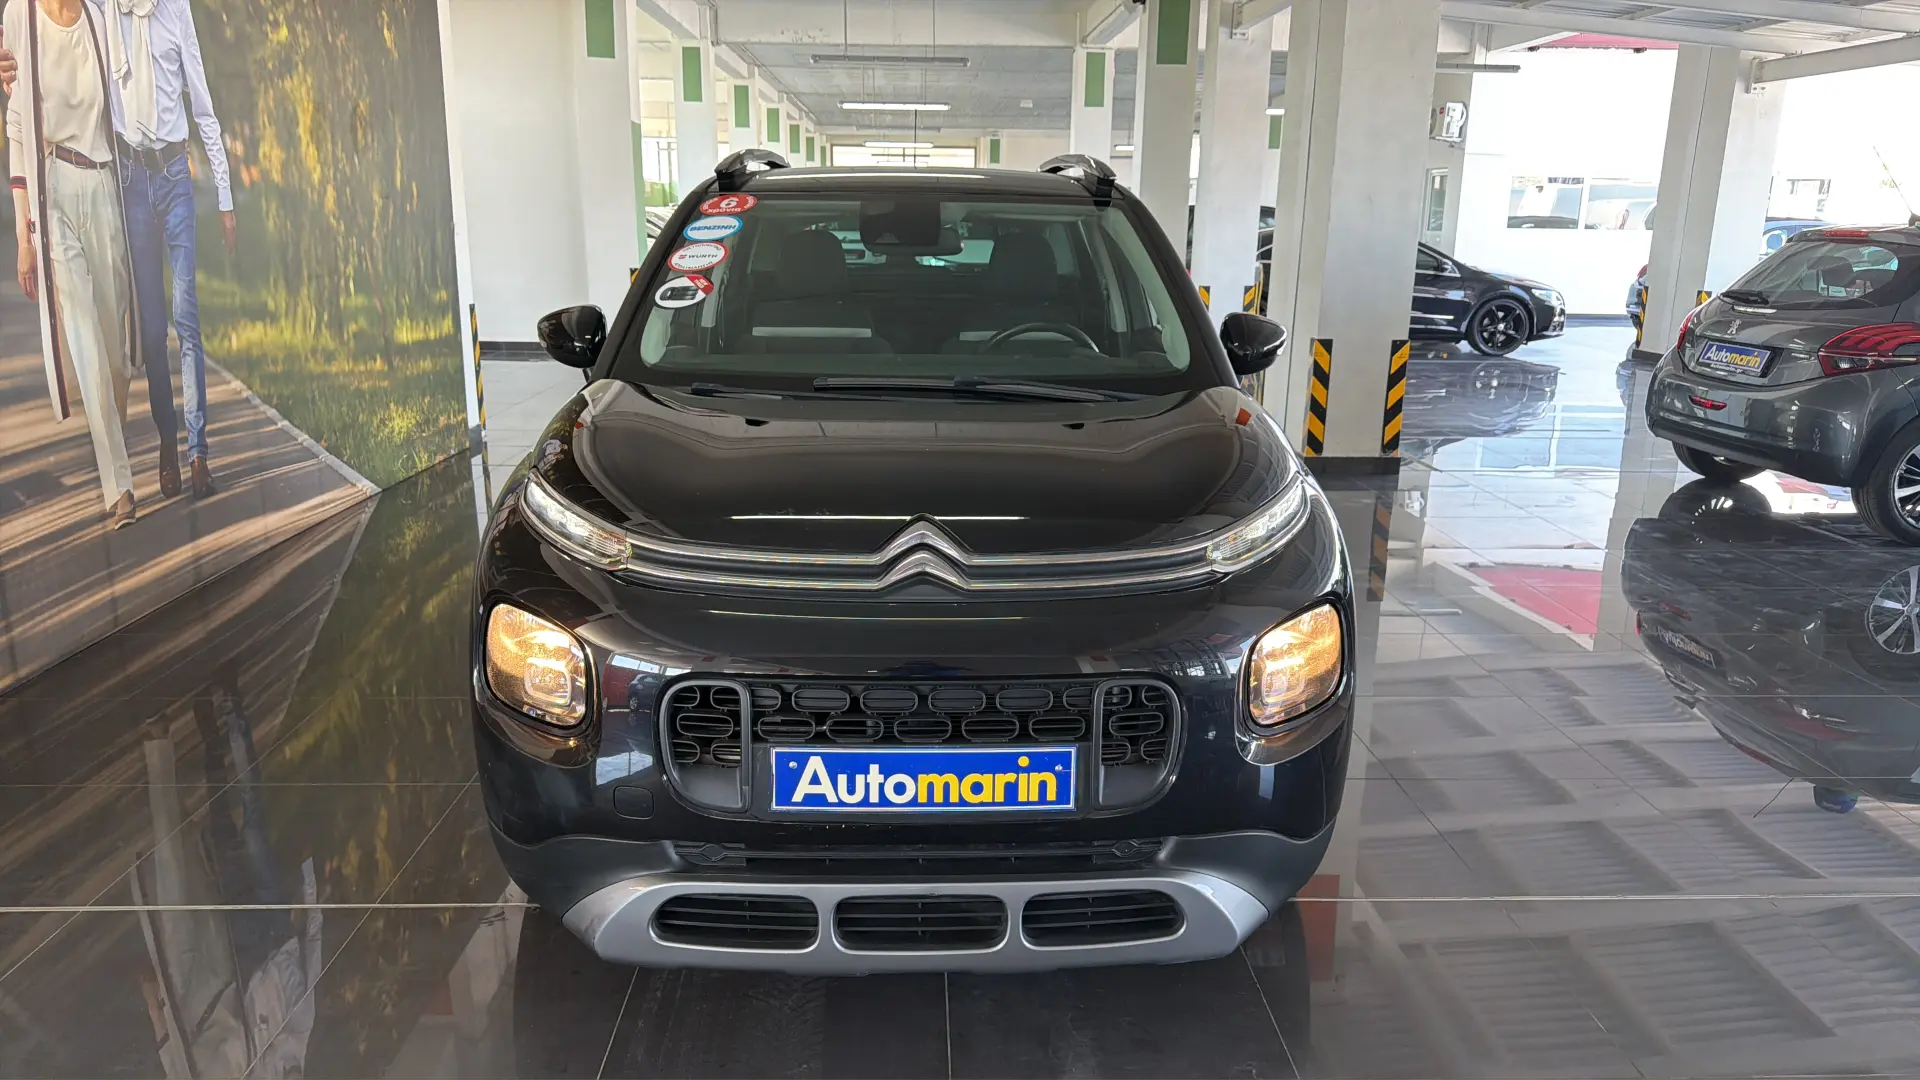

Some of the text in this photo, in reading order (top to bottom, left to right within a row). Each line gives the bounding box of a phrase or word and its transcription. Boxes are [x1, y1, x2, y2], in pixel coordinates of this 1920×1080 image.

[720, 197, 739, 208] 6
[1705, 344, 1761, 368] Automarin
[791, 755, 1057, 804] Automarin
